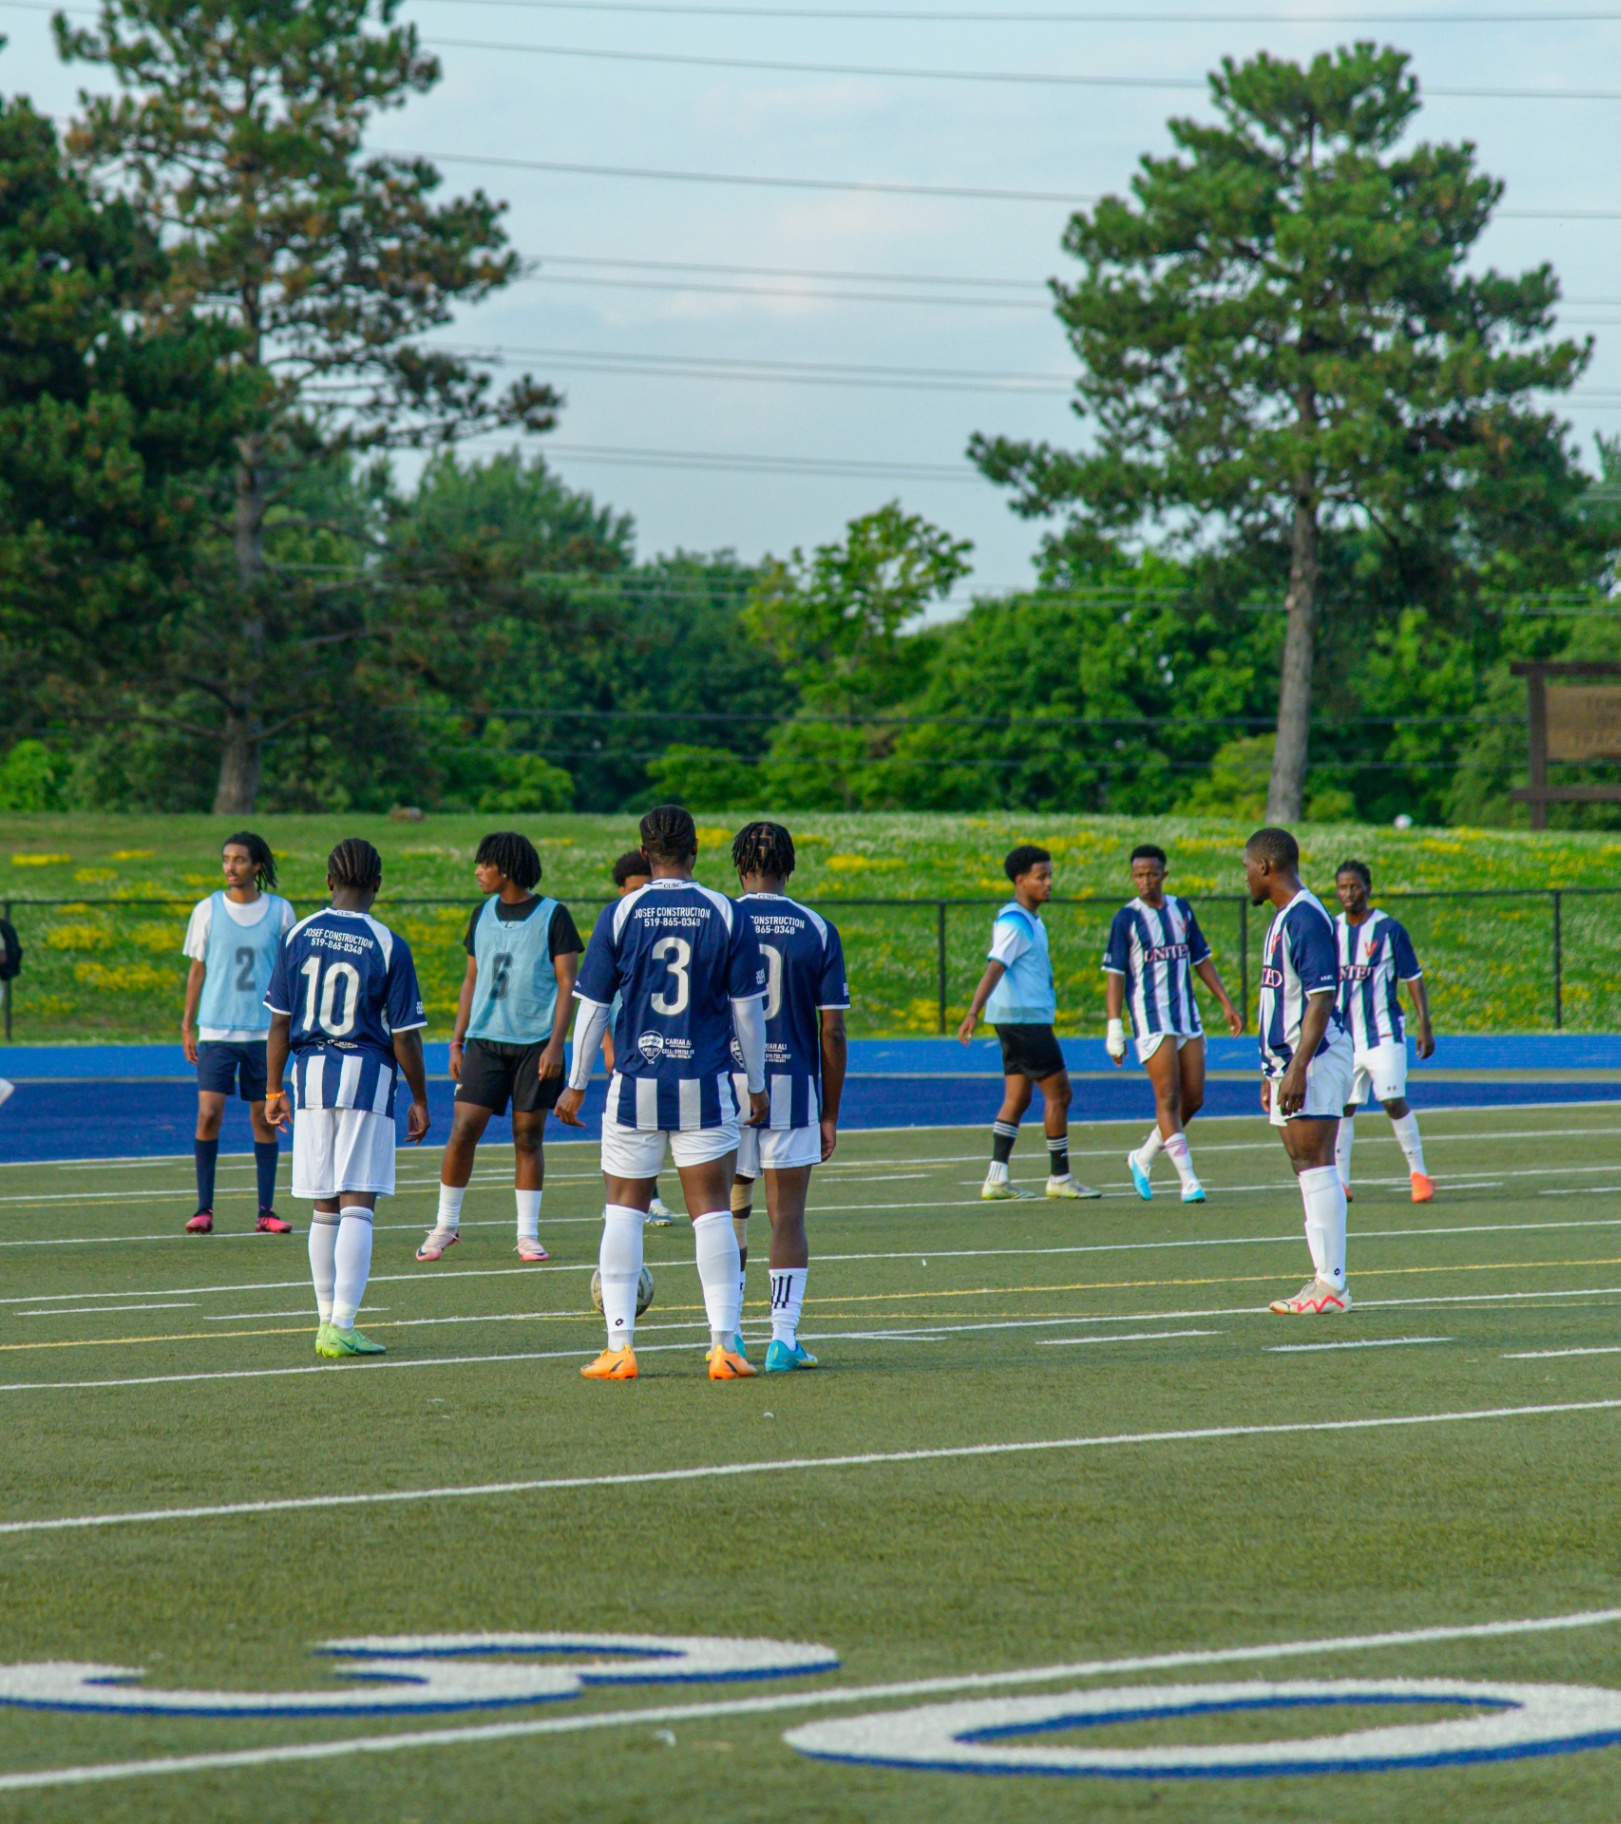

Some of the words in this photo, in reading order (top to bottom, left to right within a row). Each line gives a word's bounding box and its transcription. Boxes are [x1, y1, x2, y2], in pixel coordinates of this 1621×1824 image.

[633, 907, 656, 919] JOSEF
[656, 906, 711, 919] CONSTRUCTION
[303, 928, 325, 938] JOSEF
[323, 929, 374, 949] CONSTRUCTION
[235, 945, 257, 992] 2
[490, 951, 514, 1001] 6
[651, 936, 691, 1016] 3
[300, 955, 360, 1037] 10
